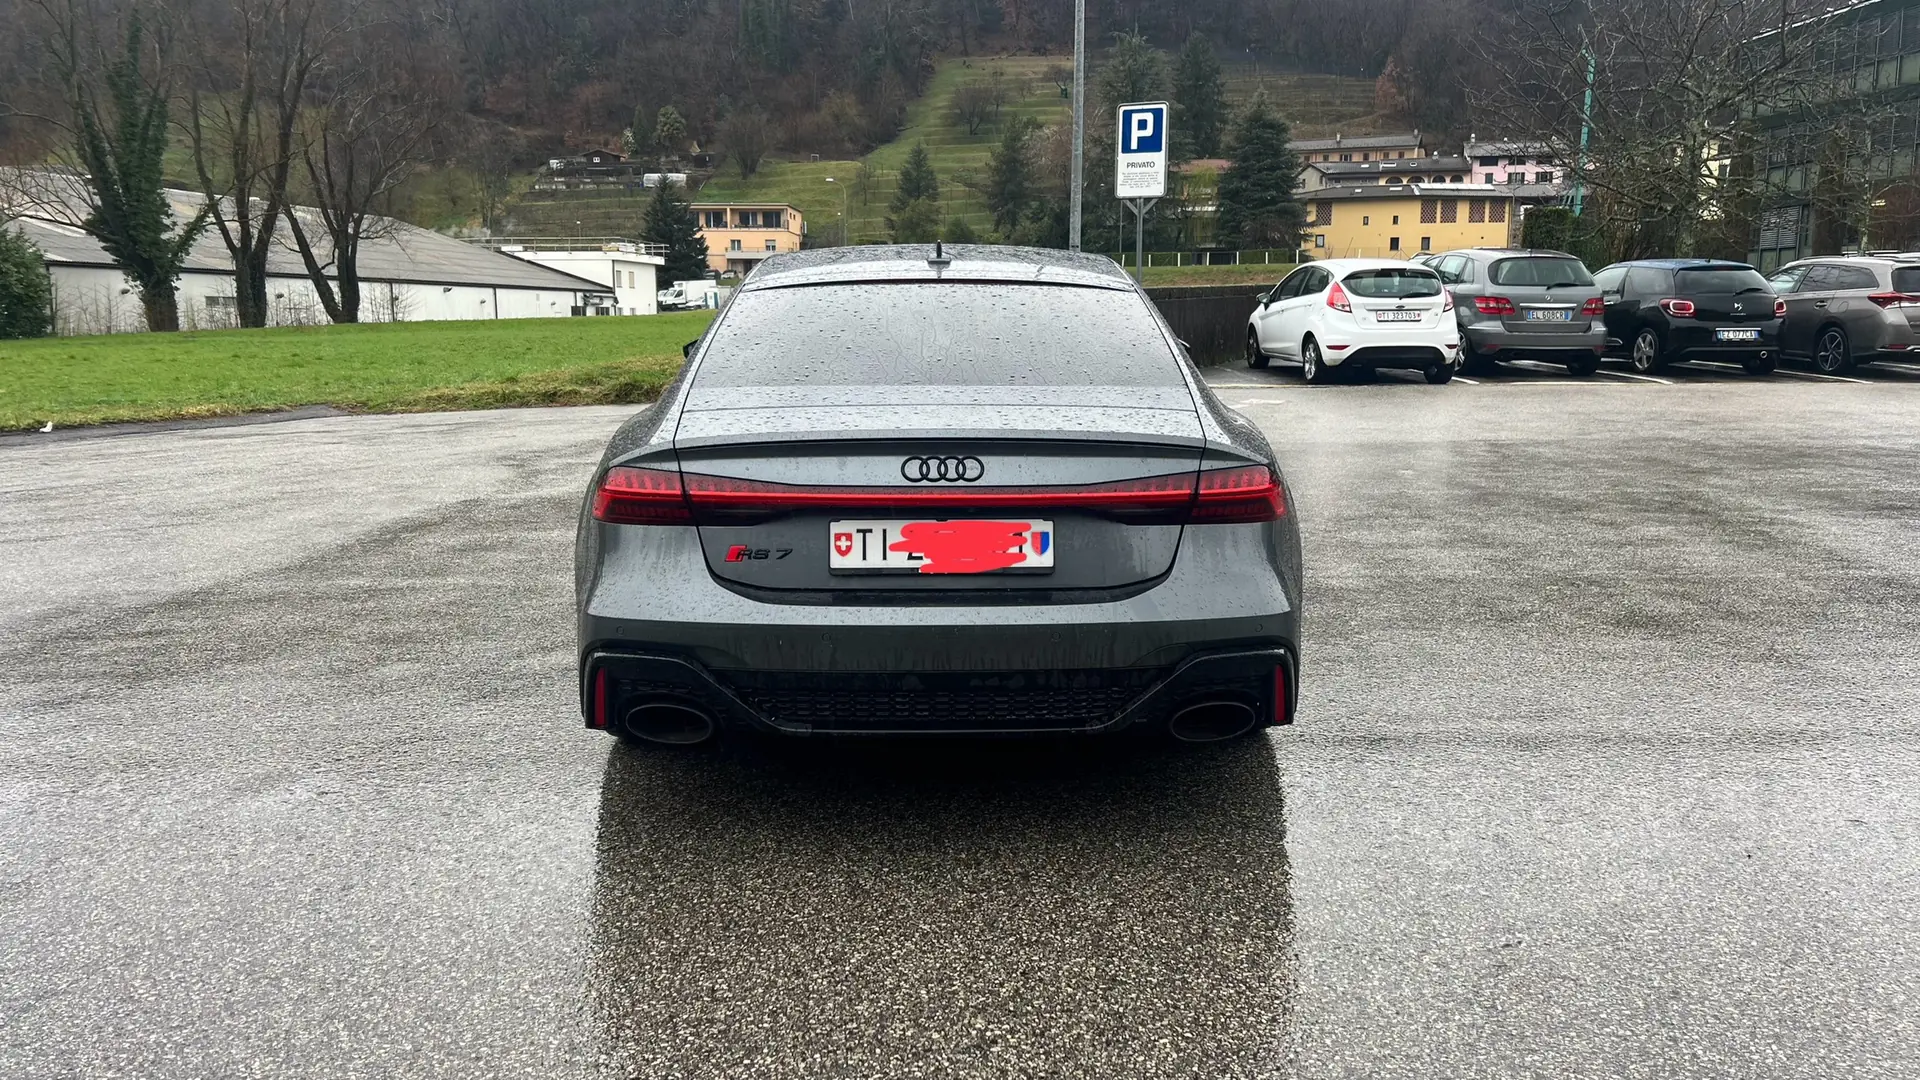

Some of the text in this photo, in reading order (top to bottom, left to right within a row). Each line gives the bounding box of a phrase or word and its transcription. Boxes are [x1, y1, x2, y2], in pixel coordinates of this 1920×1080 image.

[1130, 112, 1154, 150] P
[1126, 161, 1156, 169] PRIVATO
[1531, 311, 1540, 320] EL
[856, 528, 887, 561] TI
[735, 548, 793, 561] RS 7
